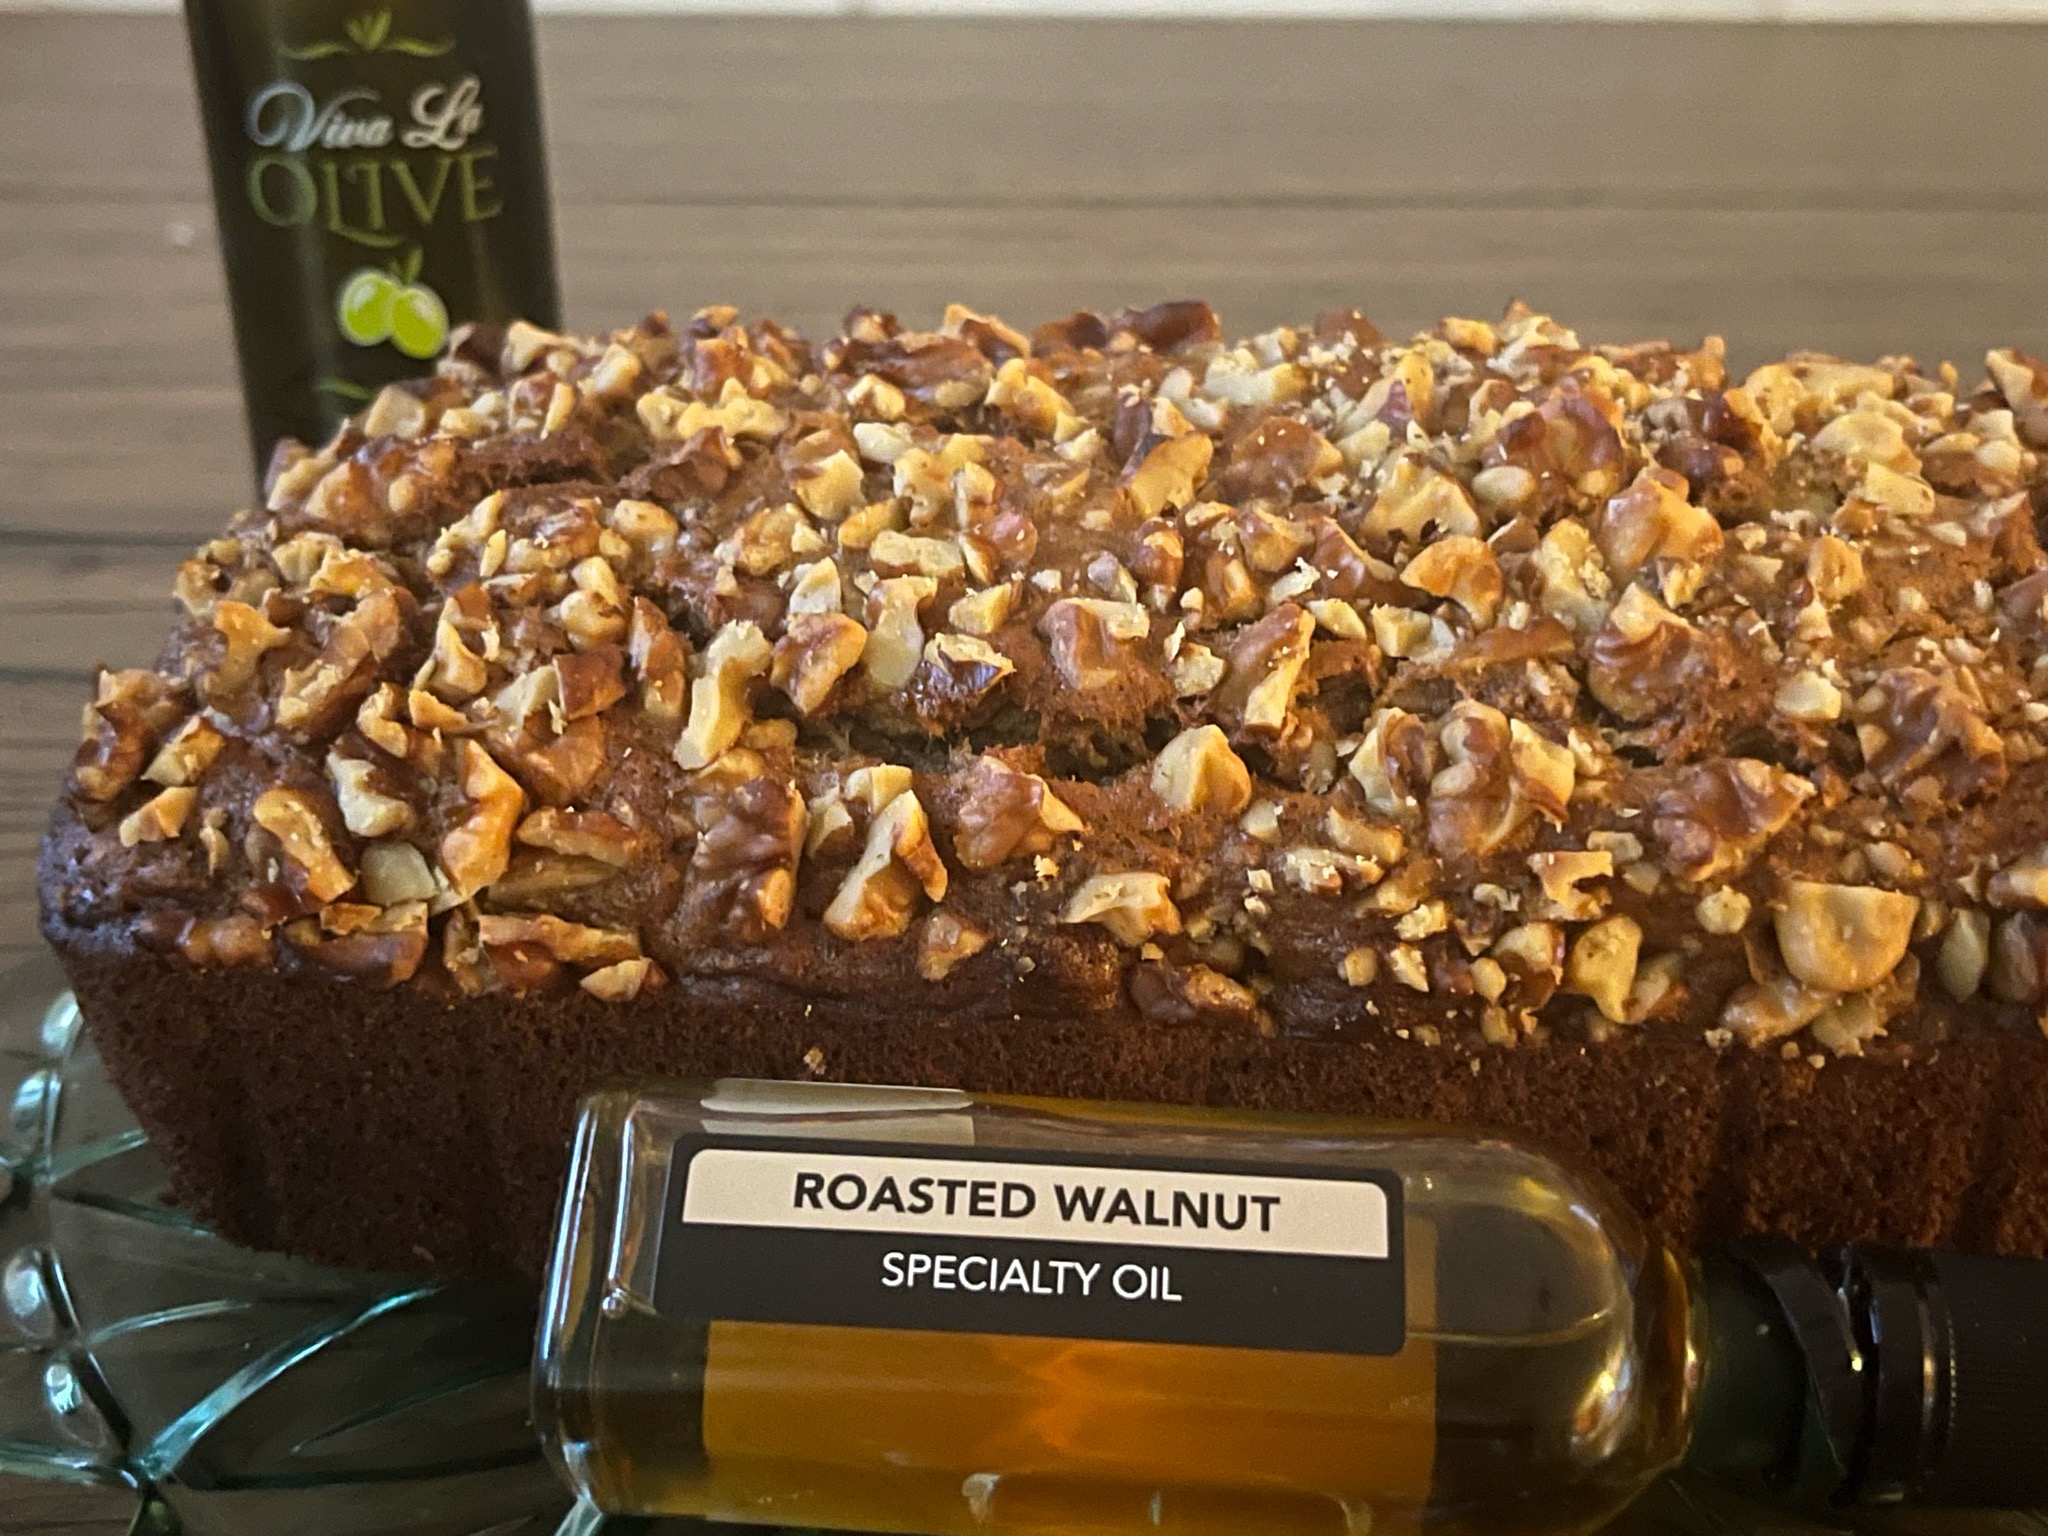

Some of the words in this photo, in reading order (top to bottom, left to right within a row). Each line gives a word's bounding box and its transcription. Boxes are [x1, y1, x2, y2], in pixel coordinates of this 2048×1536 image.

[247, 79, 394, 152] Viva
[403, 74, 483, 150] La
[248, 145, 501, 248] OLIVE
[793, 1172, 1036, 1220] ROASTED
[1055, 1186, 1281, 1232] WALNUT
[881, 1252, 1101, 1296] SPECIALTY
[1112, 1264, 1183, 1302] OIL
